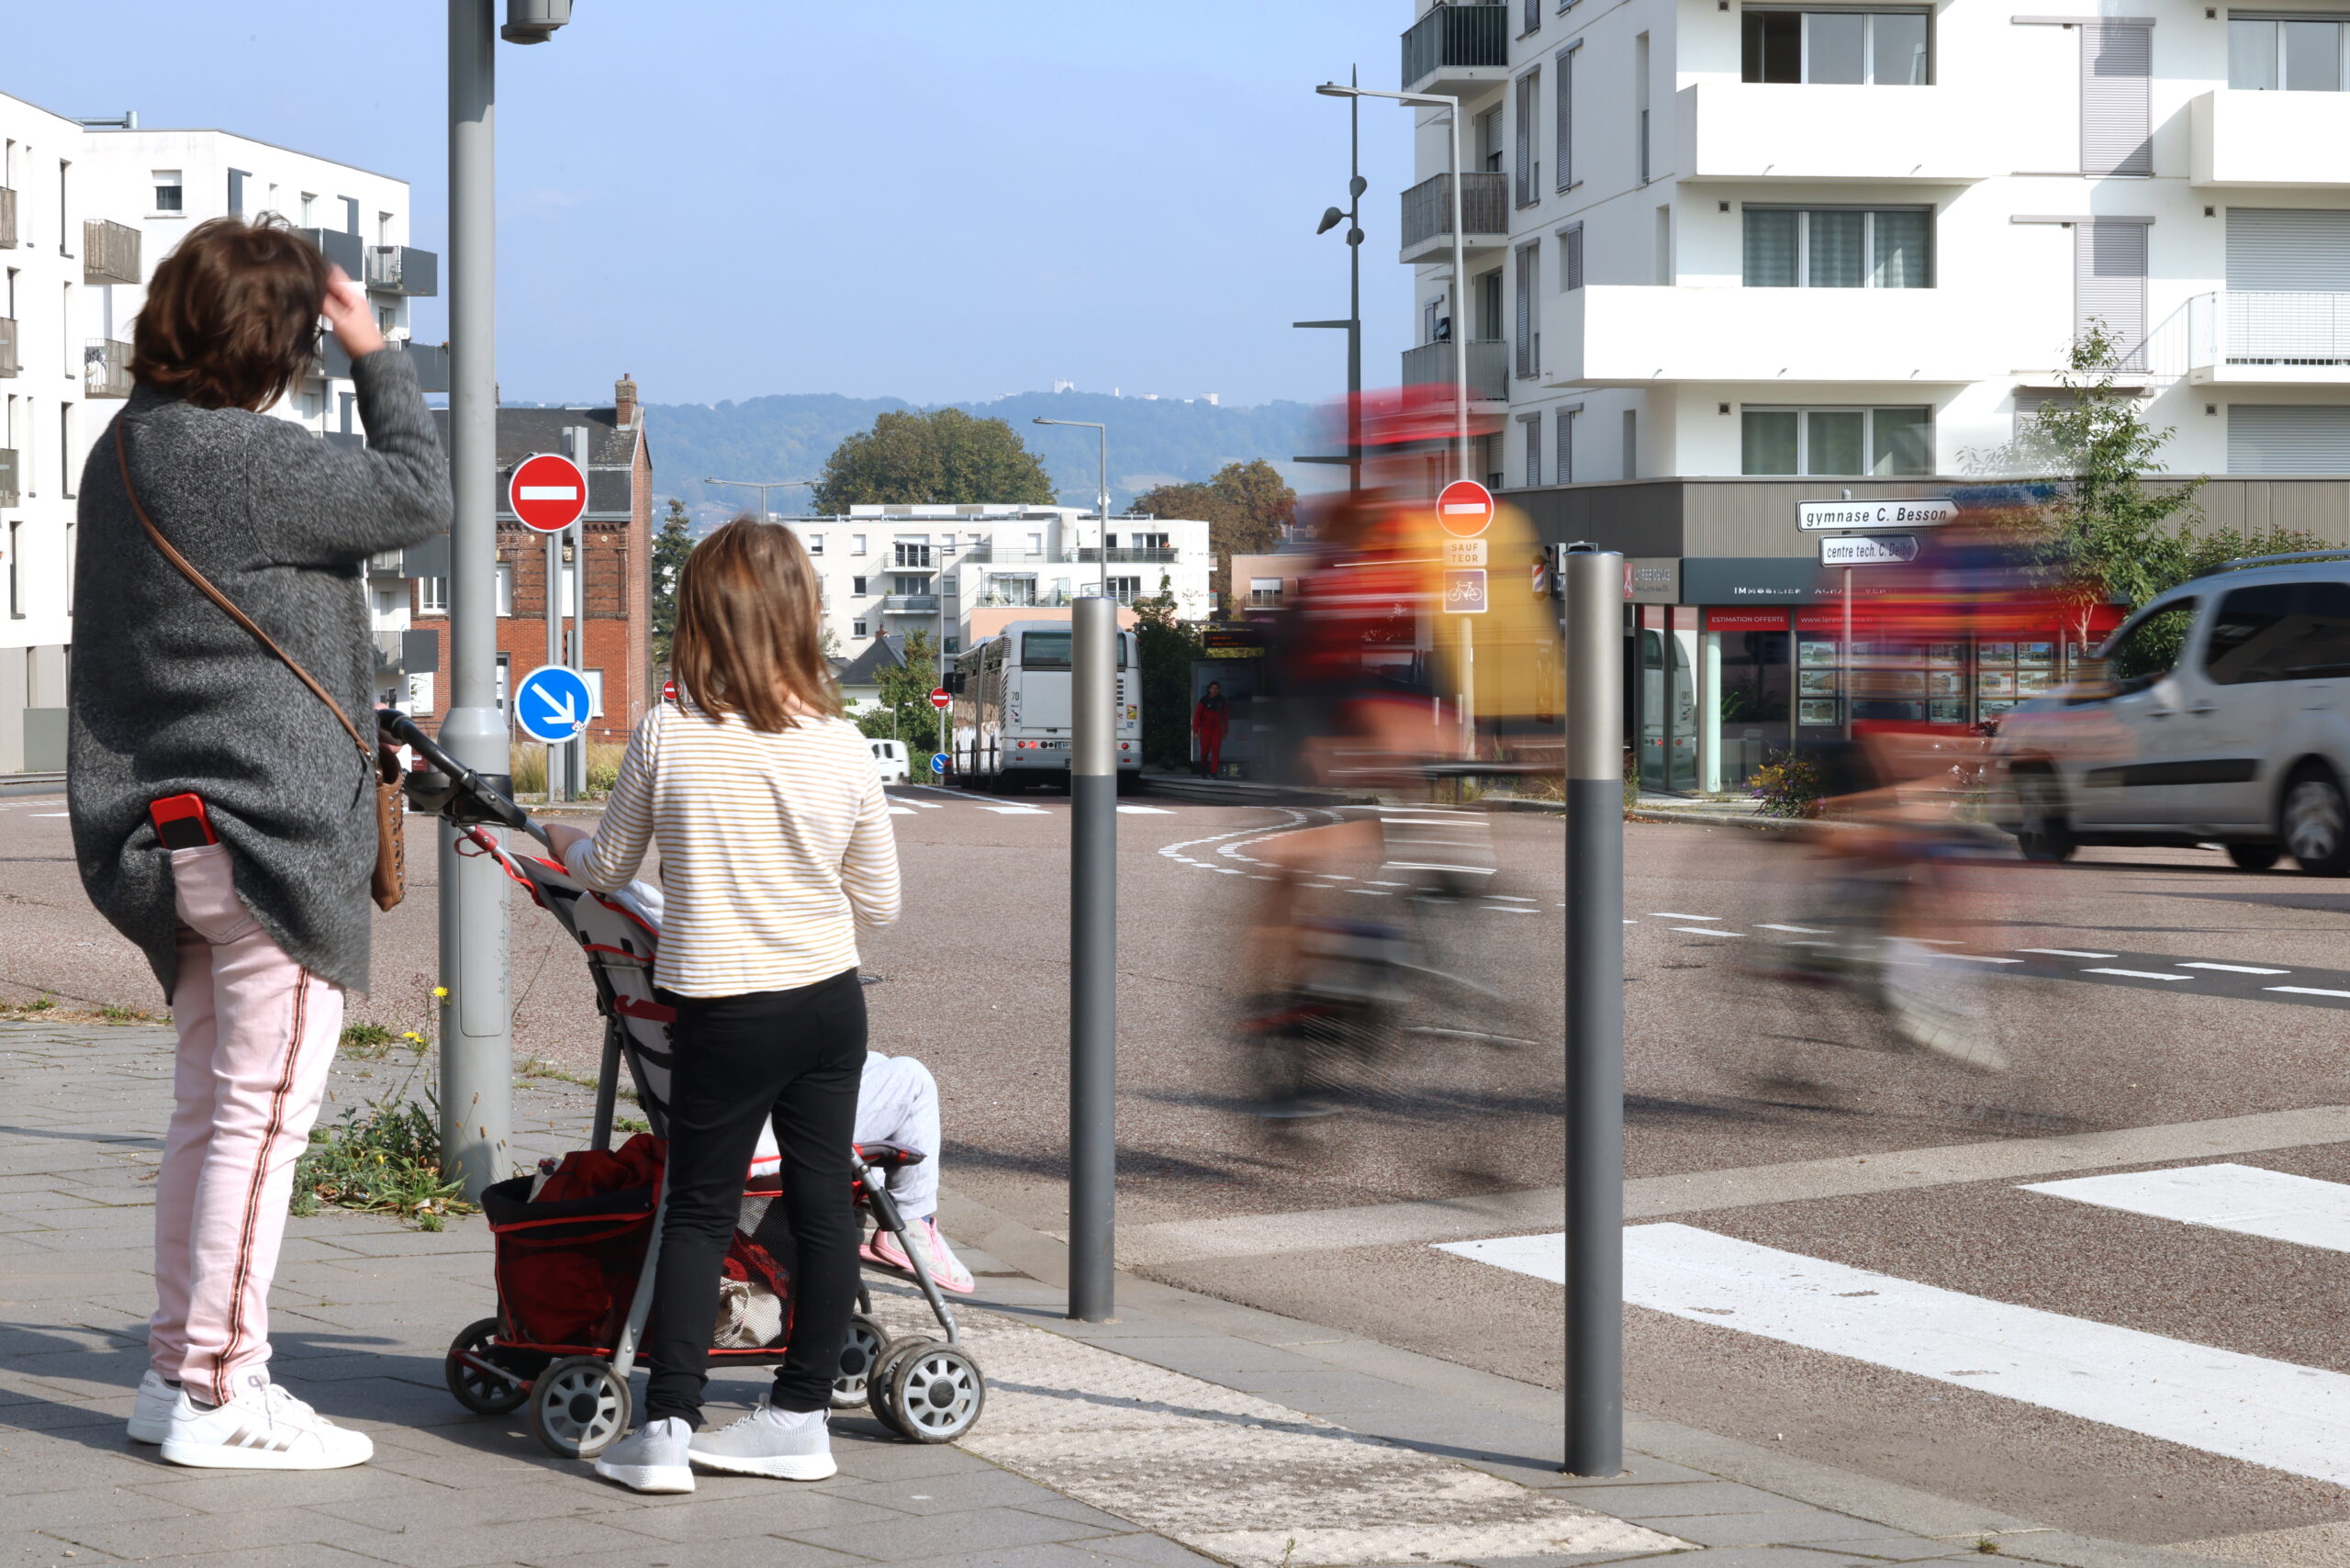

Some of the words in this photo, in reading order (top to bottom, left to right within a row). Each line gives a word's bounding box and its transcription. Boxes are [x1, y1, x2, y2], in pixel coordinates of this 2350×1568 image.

[1807, 510, 1870, 526] gymnase
[1876, 508, 1890, 521] C.
[1897, 507, 1947, 521] Besson
[1451, 543, 1479, 552] SAUF
[1827, 545, 1853, 558] centre
[1856, 543, 1876, 557] tech.
[1878, 543, 1886, 556] C.
[1889, 543, 1912, 556] Delbo
[1452, 554, 1479, 563] TEOR
[1011, 690, 1020, 701] 70
